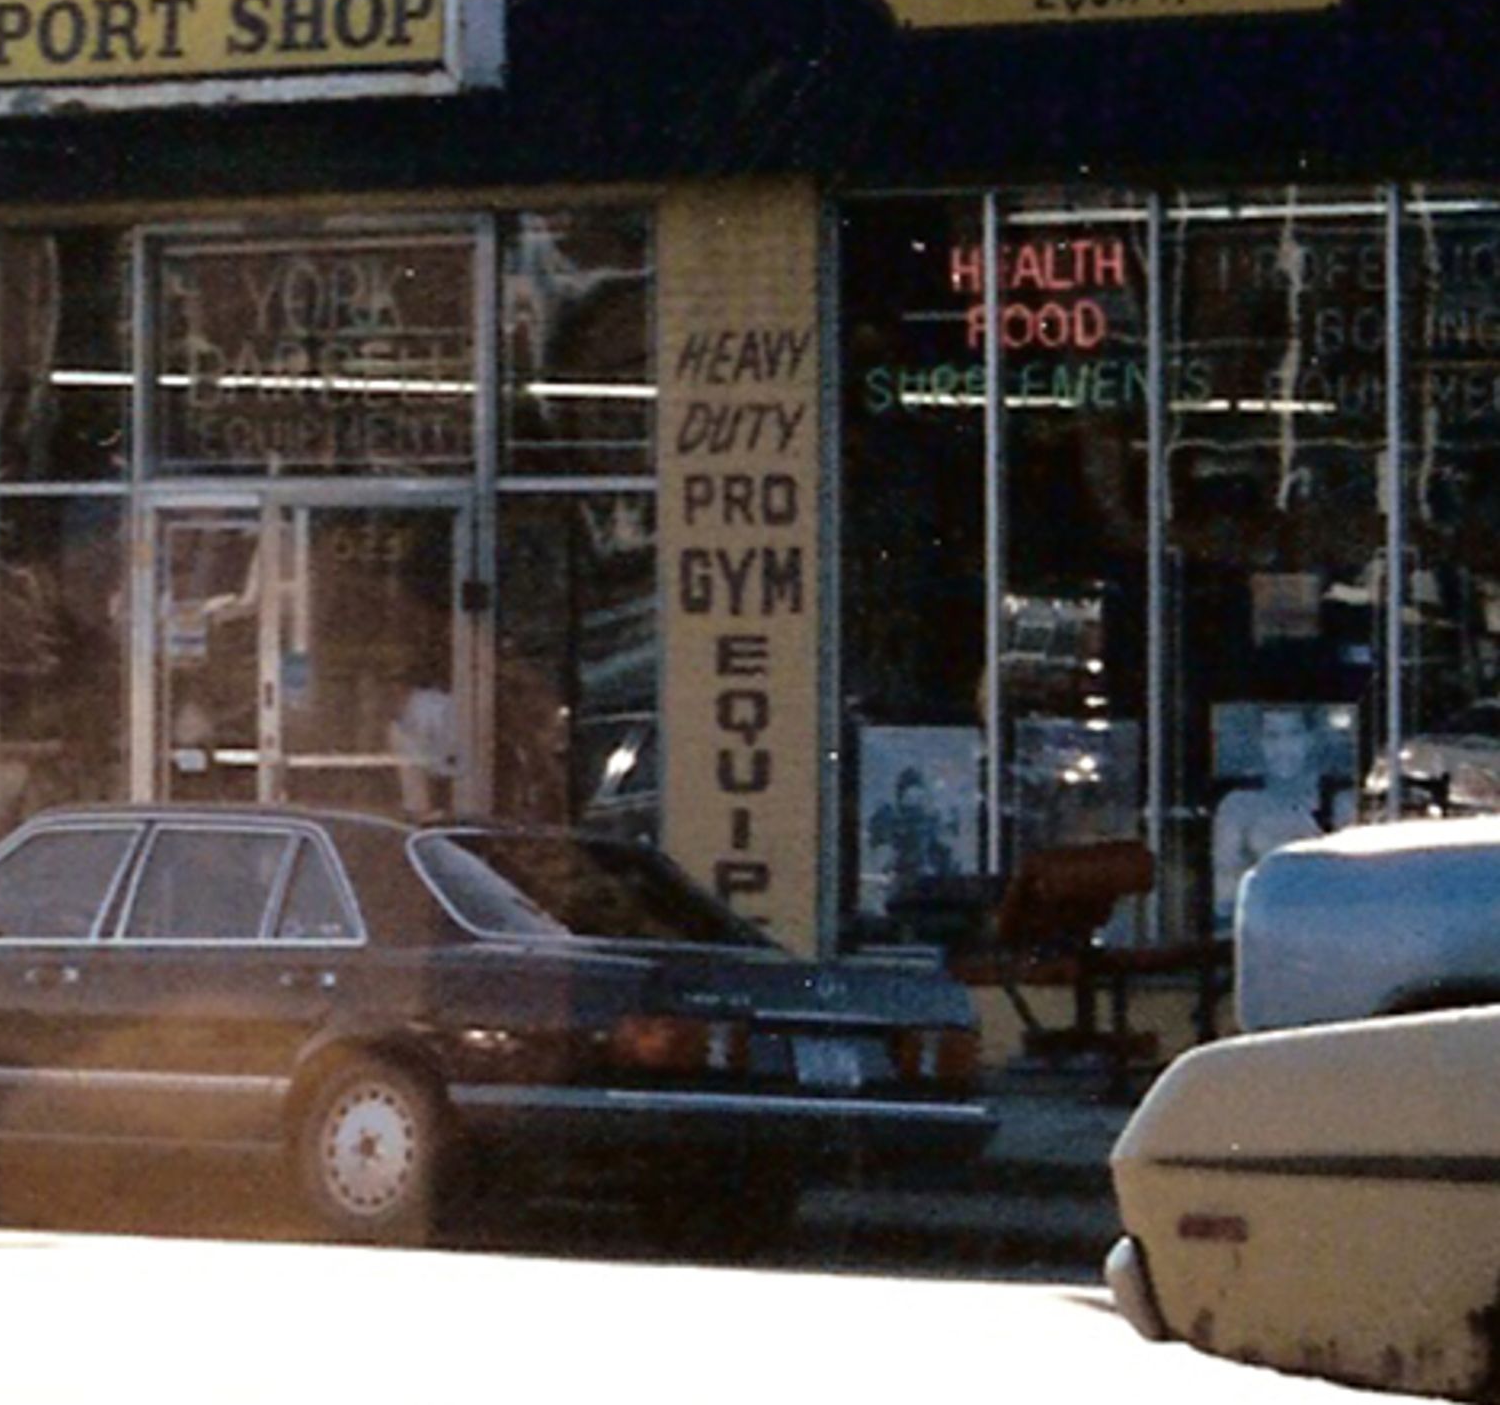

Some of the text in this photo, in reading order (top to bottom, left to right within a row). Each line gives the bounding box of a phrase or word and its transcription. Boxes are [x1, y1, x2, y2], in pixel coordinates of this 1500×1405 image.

[951, 239, 1126, 292] HALTH
[966, 299, 1109, 350] FOOD
[676, 328, 810, 385] HEAVY
[866, 362, 1212, 412] SUPPEMENS
[677, 401, 805, 458] DUTY
[683, 473, 799, 526] PRO
[678, 547, 805, 616] GYM
